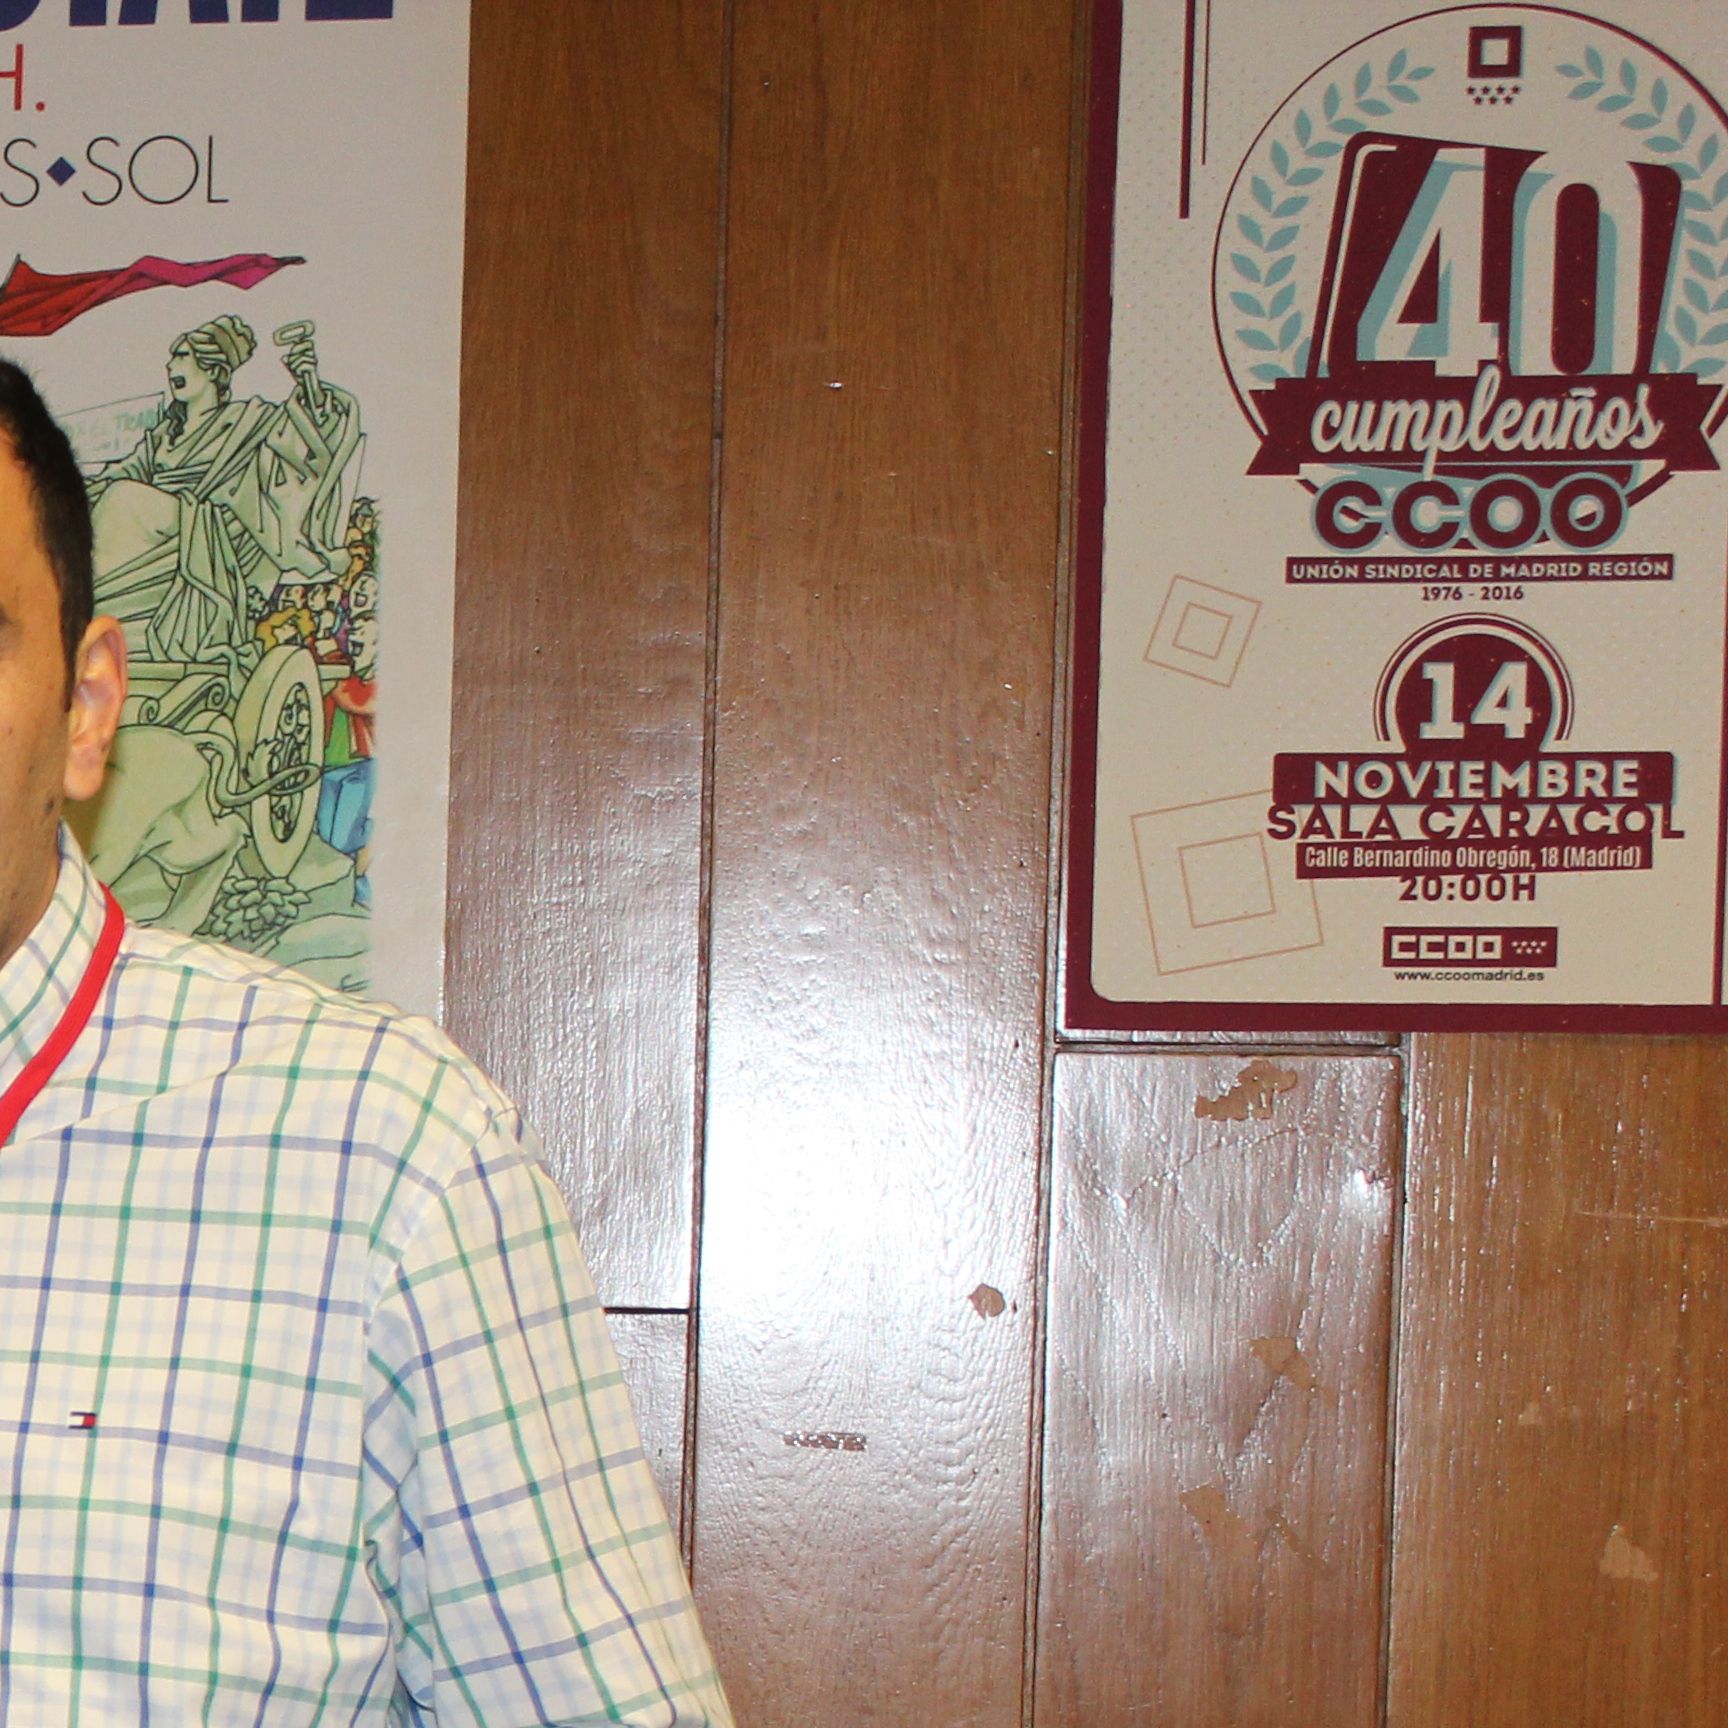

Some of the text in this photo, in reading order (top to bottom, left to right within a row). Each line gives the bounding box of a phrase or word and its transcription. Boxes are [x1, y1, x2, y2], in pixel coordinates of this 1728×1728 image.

[81, 134, 229, 206] SOL
[1355, 145, 1644, 379] 40
[1310, 363, 1664, 481] cumpleaños
[1310, 472, 1629, 554] CCOO
[1292, 555, 1669, 580] UNIÓN SINDICAL DE MADRID REGIÓN
[1421, 584, 1525, 601] 1976 2016
[1418, 660, 1534, 740] 14
[1313, 759, 1640, 800] NOVIEMBRE
[1266, 802, 1685, 841] SALA CARACOL
[1304, 844, 1641, 871] Calle Bernardino Obregón, 18 (Madrid)
[1398, 873, 1537, 902] 20:00H
[1390, 934, 1503, 961] CCOO
[1394, 969, 1545, 982] www.ccoomadrid.es
